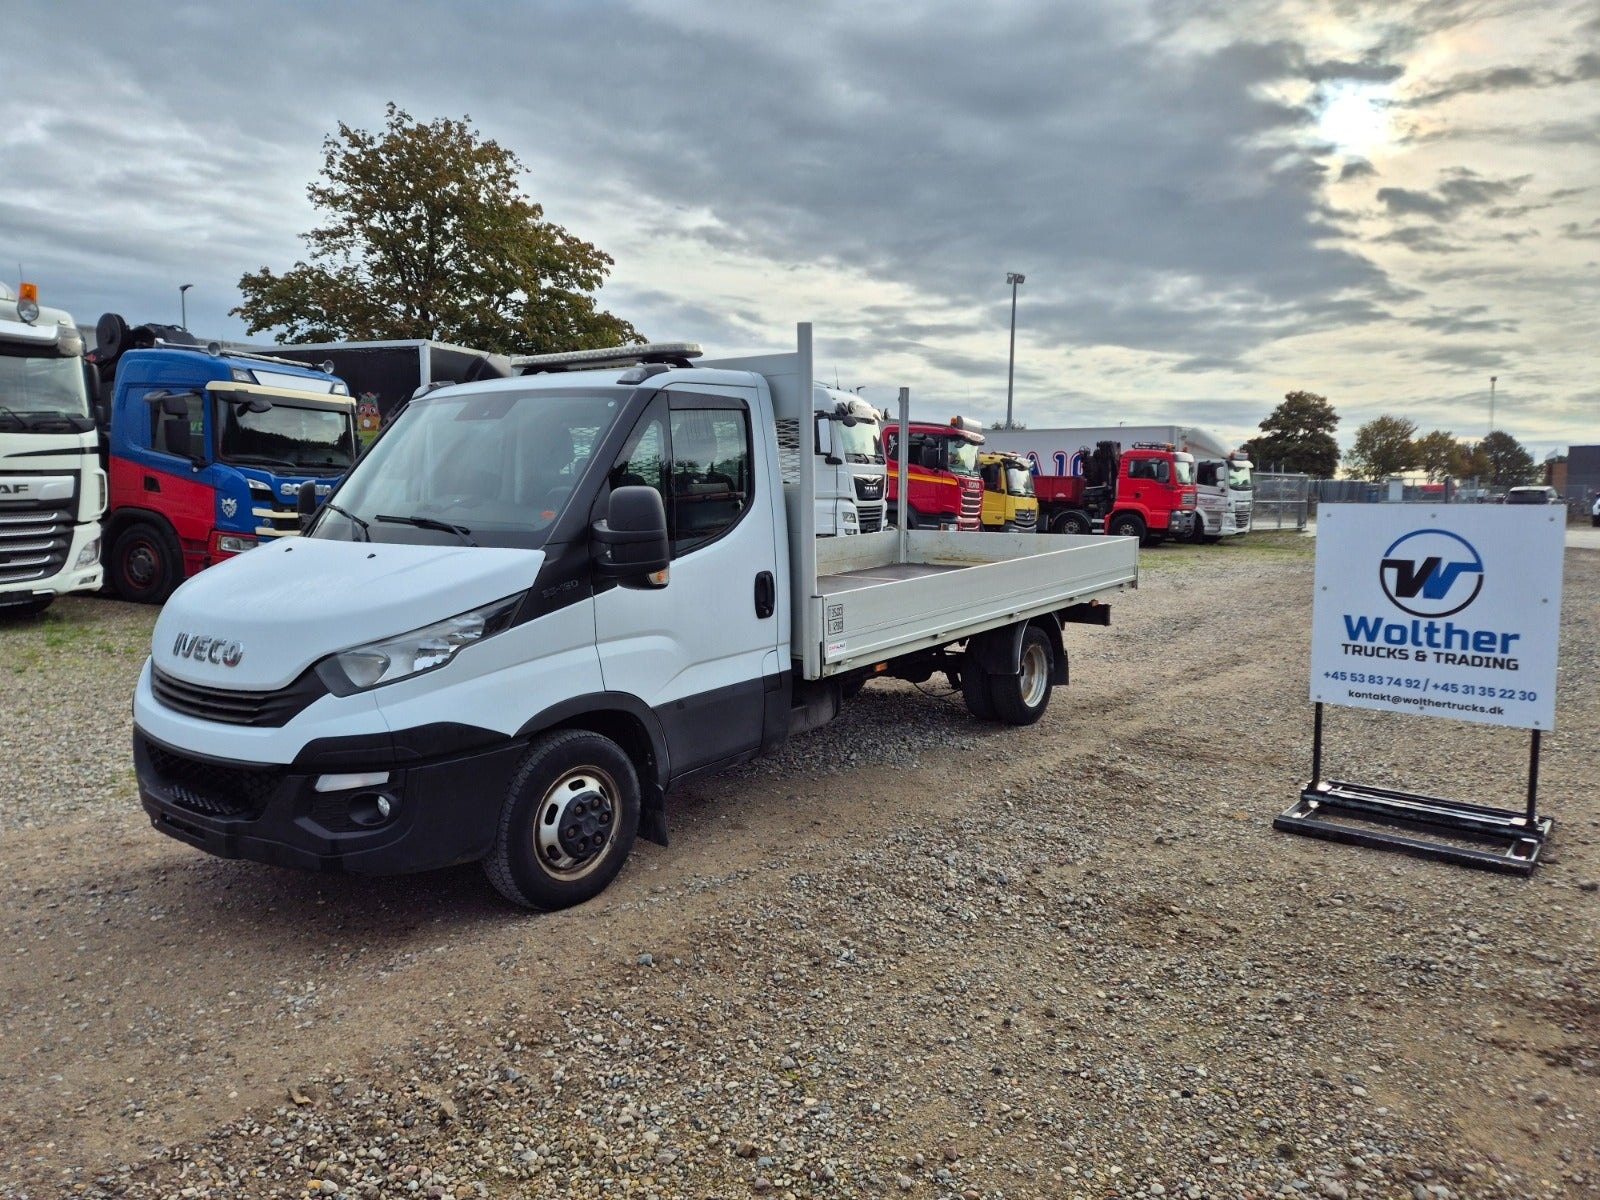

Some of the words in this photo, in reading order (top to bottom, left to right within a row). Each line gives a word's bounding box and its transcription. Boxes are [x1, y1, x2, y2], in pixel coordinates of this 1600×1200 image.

[172, 631, 244, 668] IVECO
[1343, 614, 1520, 655] Wolther
[1341, 643, 1410, 661] TRUCKS
[1414, 650, 1428, 663] &
[1433, 651, 1520, 671] TRADING
[1323, 671, 1347, 681] +45
[1350, 672, 1365, 683] 53
[1367, 674, 1384, 685] 83
[1386, 676, 1402, 687] 74
[1405, 678, 1421, 689] 92
[1432, 683, 1459, 693] +45
[1462, 684, 1475, 695] 31
[1478, 686, 1496, 697] 35
[1499, 688, 1515, 700] 22
[1518, 690, 1537, 702] 30
[1348, 689, 1504, 715] kontakt@wolthertrucks.dk
